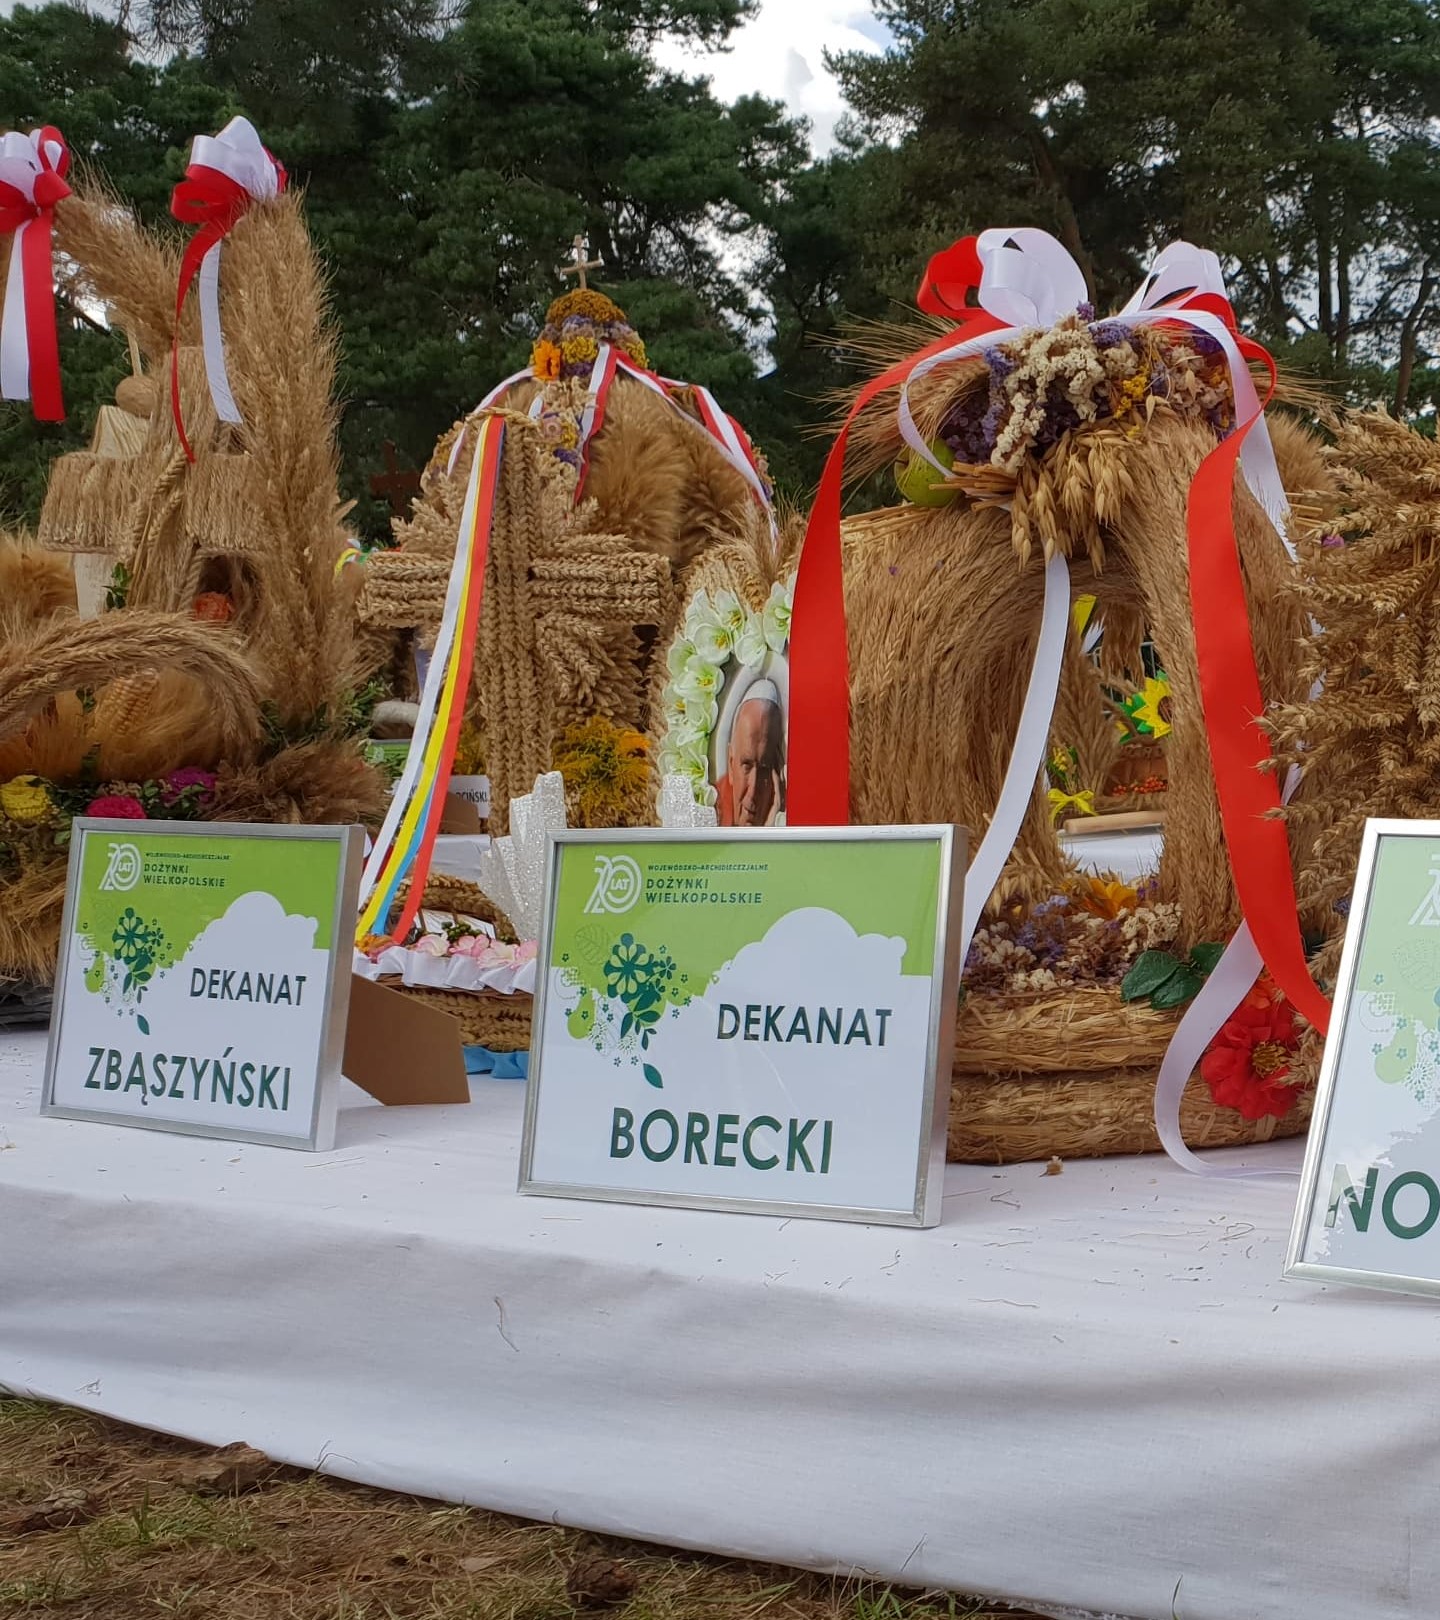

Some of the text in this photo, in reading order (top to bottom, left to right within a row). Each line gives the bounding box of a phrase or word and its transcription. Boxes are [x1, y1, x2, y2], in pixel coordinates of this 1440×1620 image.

[144, 863, 189, 874] DOŻYNKI
[143, 875, 225, 887] WIELKOPOLSKIE
[610, 878, 630, 891] LAT
[646, 876, 709, 889] DOŻYNKI
[645, 892, 762, 904] WIELKOPOLSKIE
[190, 968, 307, 1006] DEKANAT
[717, 1003, 892, 1046] DEKANAT
[84, 1047, 291, 1111] ZBĄSZYŃSKI
[610, 1107, 833, 1174] BORECKI
